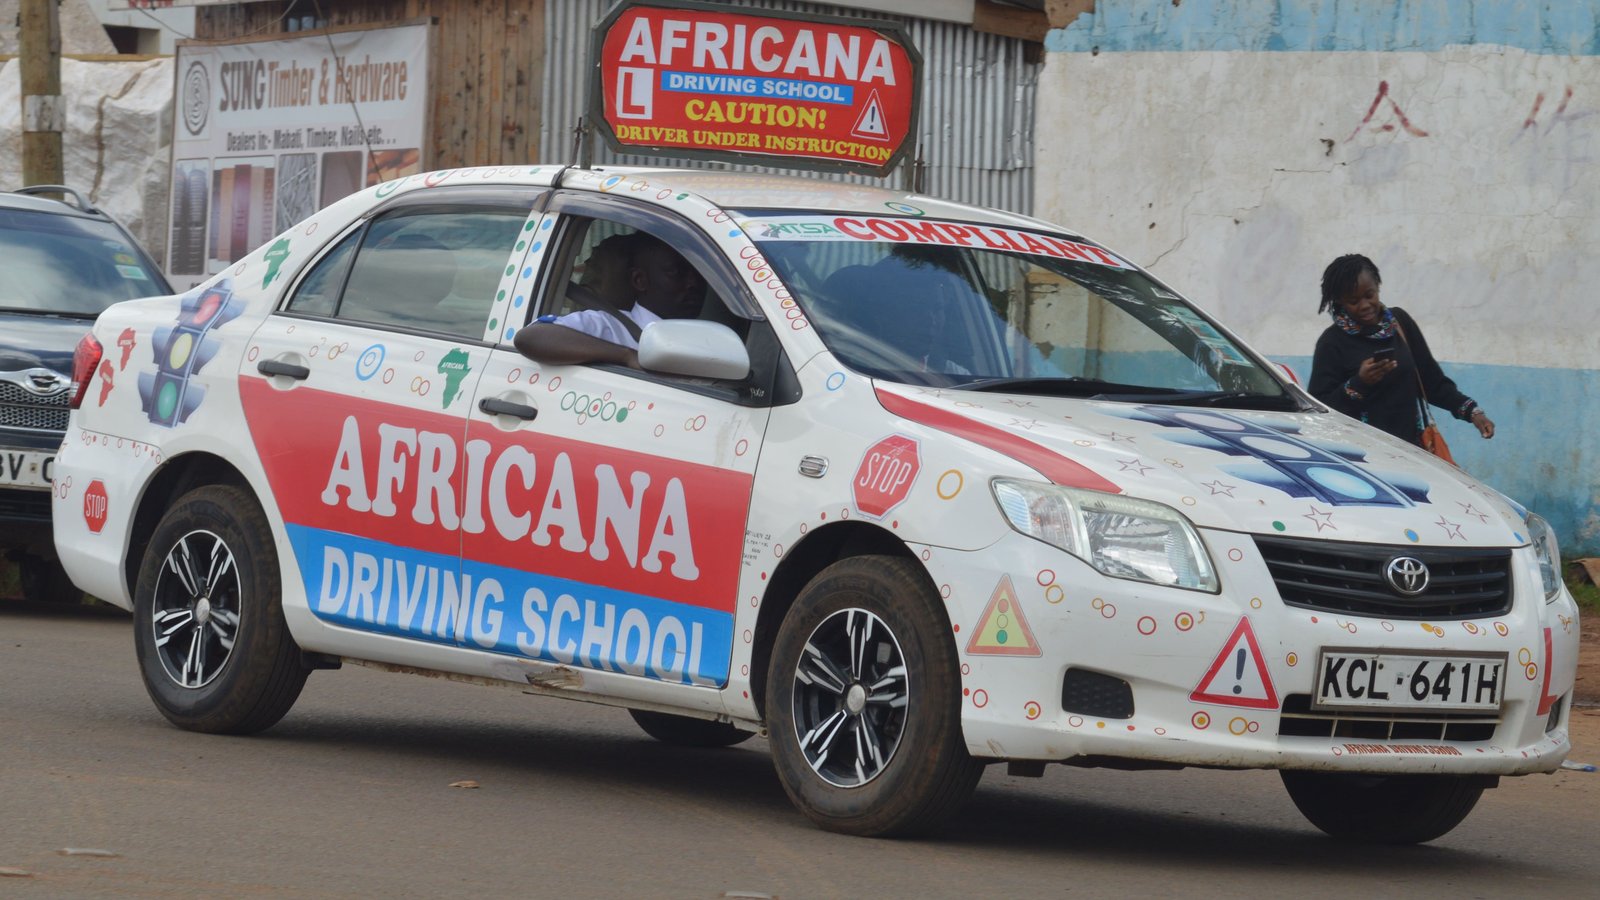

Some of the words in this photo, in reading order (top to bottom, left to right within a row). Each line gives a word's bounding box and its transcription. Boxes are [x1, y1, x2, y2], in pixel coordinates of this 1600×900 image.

[619, 17, 897, 86] AFRICANA
[219, 59, 266, 112] SUNG
[268, 60, 315, 108] Timber
[319, 57, 330, 105] &
[334, 55, 408, 104] Hardware
[621, 71, 647, 116] L
[669, 73, 757, 95] DRIVING
[762, 80, 845, 102] SCHOOL
[684, 99, 828, 130] CAUTION!
[227, 131, 256, 151] Dealers
[616, 124, 690, 145] DRIVER
[693, 130, 760, 149] UNDER
[765, 135, 893, 161] INSTRUCTION
[833, 217, 1121, 267] COMPLIANT
[859, 452, 912, 495] STOP
[86, 494, 106, 519] STOP
[321, 414, 700, 582] AFRICANA
[318, 545, 504, 649] DRIVING
[516, 587, 718, 686] SCHOOL
[1321, 657, 1390, 700] KCL
[1409, 660, 1500, 705] 641H
